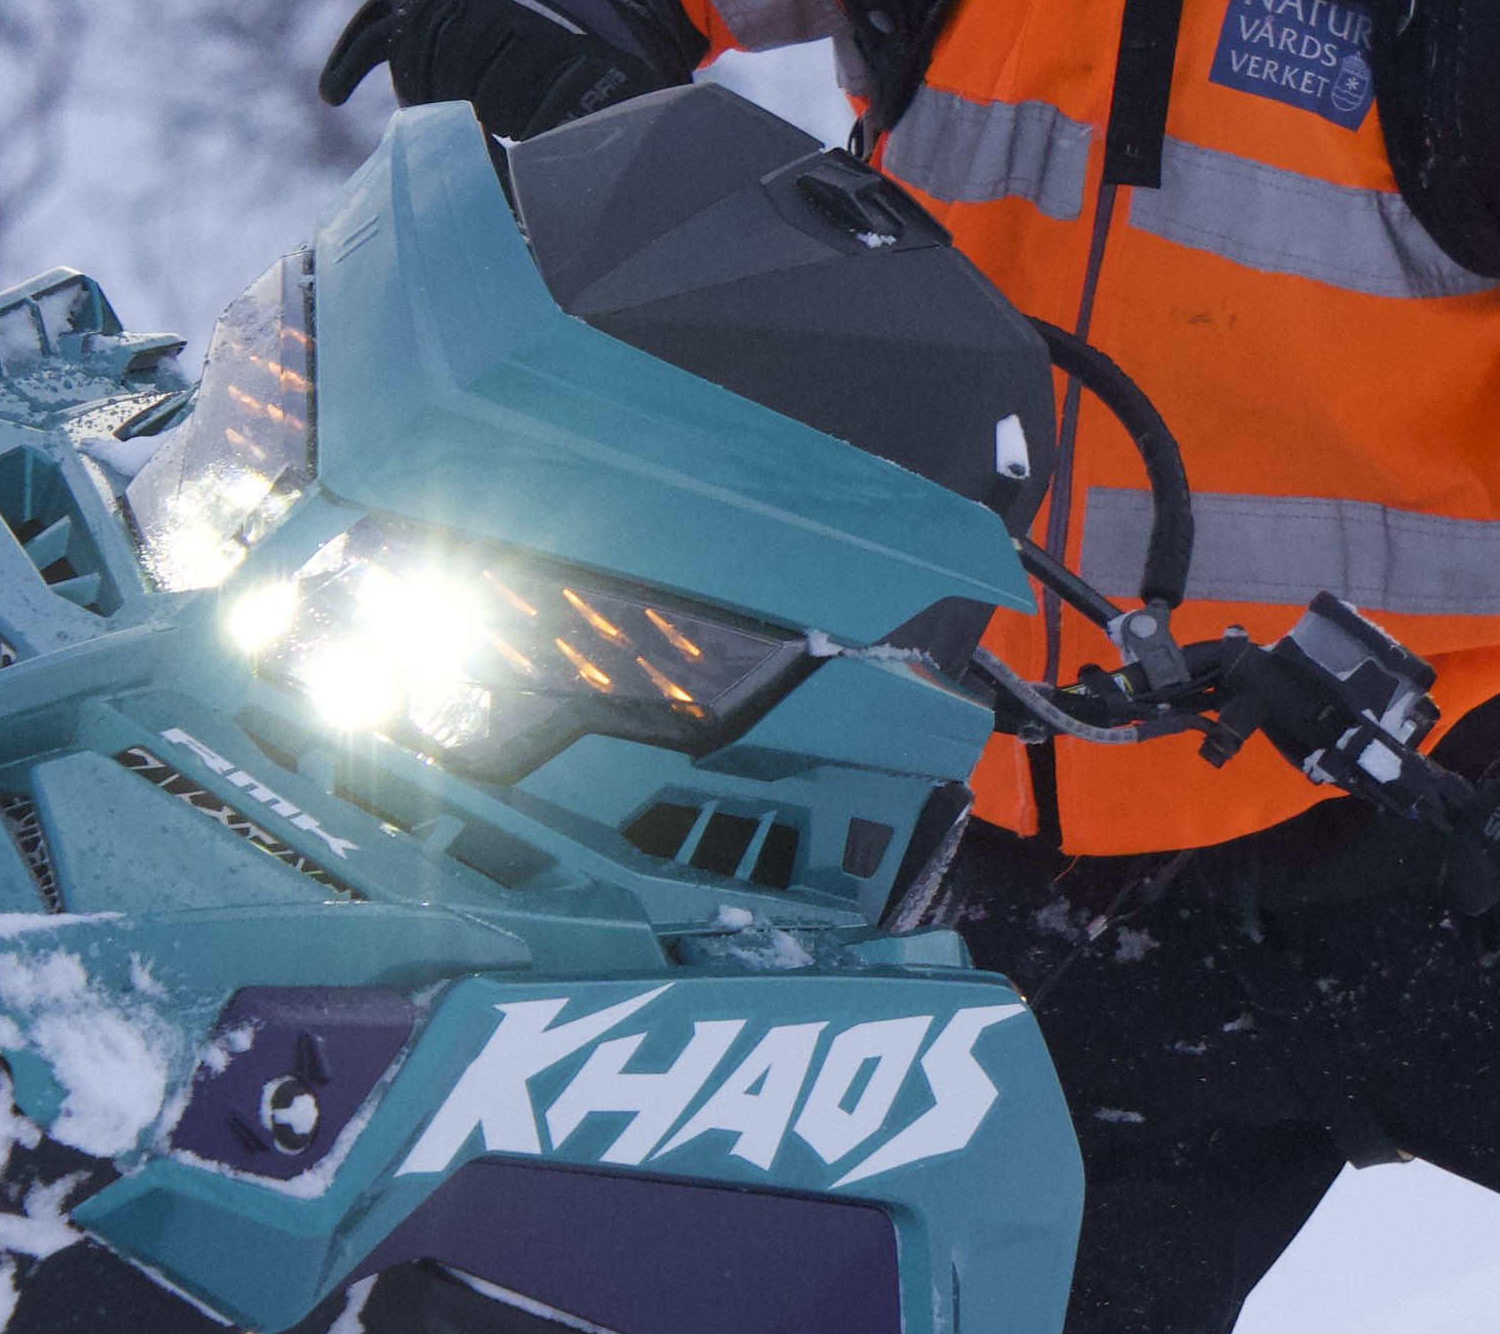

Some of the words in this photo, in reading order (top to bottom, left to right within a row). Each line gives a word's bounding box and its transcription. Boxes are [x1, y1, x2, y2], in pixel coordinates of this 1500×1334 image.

[1230, 50, 1330, 98] VERKET
[1239, 14, 1338, 67] VÅRDS
[159, 727, 360, 860] RMK
[394, 981, 1029, 1189] KHAOS
